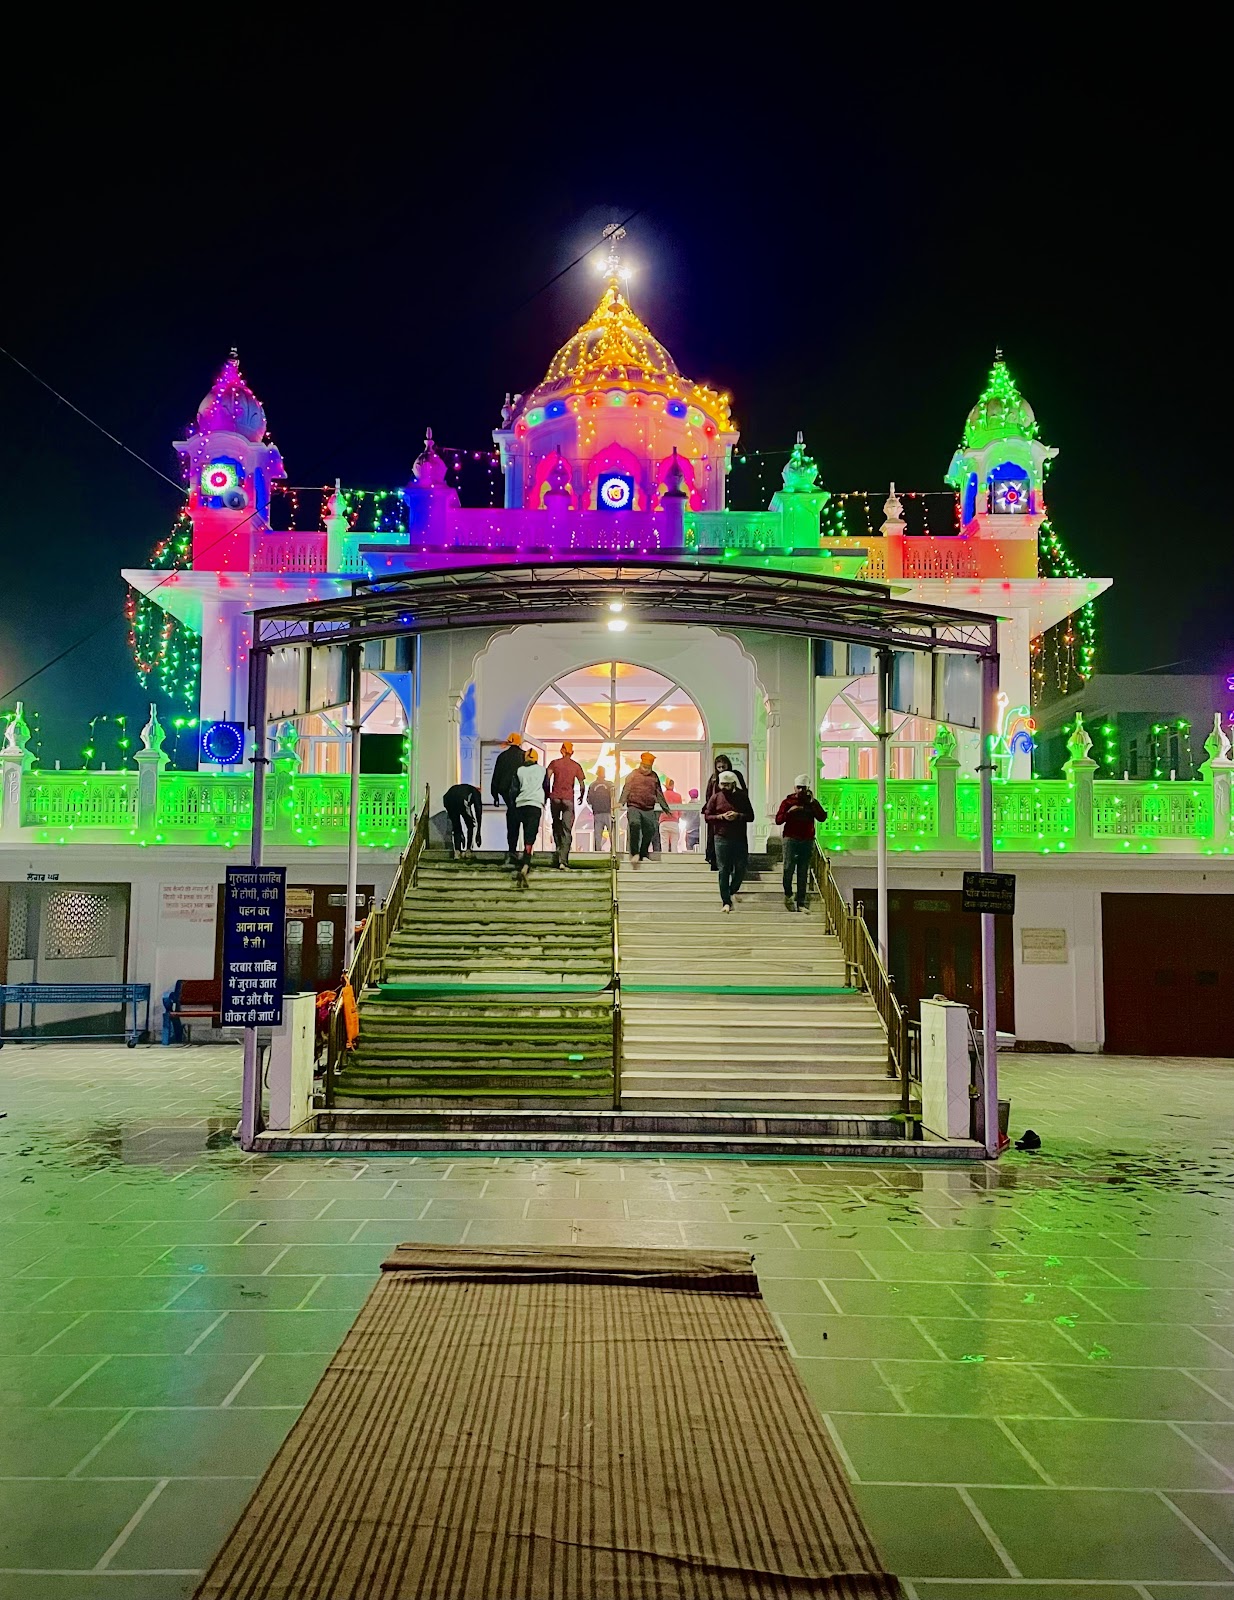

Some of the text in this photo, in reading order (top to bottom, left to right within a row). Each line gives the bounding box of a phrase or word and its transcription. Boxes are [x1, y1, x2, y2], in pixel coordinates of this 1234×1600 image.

[259, 872, 281, 883] साहिब
[231, 887, 240, 899] में
[239, 906, 270, 916] पहन कर
[236, 922, 273, 932] आना मना
[243, 935, 249, 948] है
[229, 960, 277, 972] दरबार साहिब
[229, 976, 277, 992] में जुराब उतार
[231, 991, 274, 1005] कर और पैर
[224, 1010, 247, 1022] धोकर
[248, 1009, 256, 1022] ही
